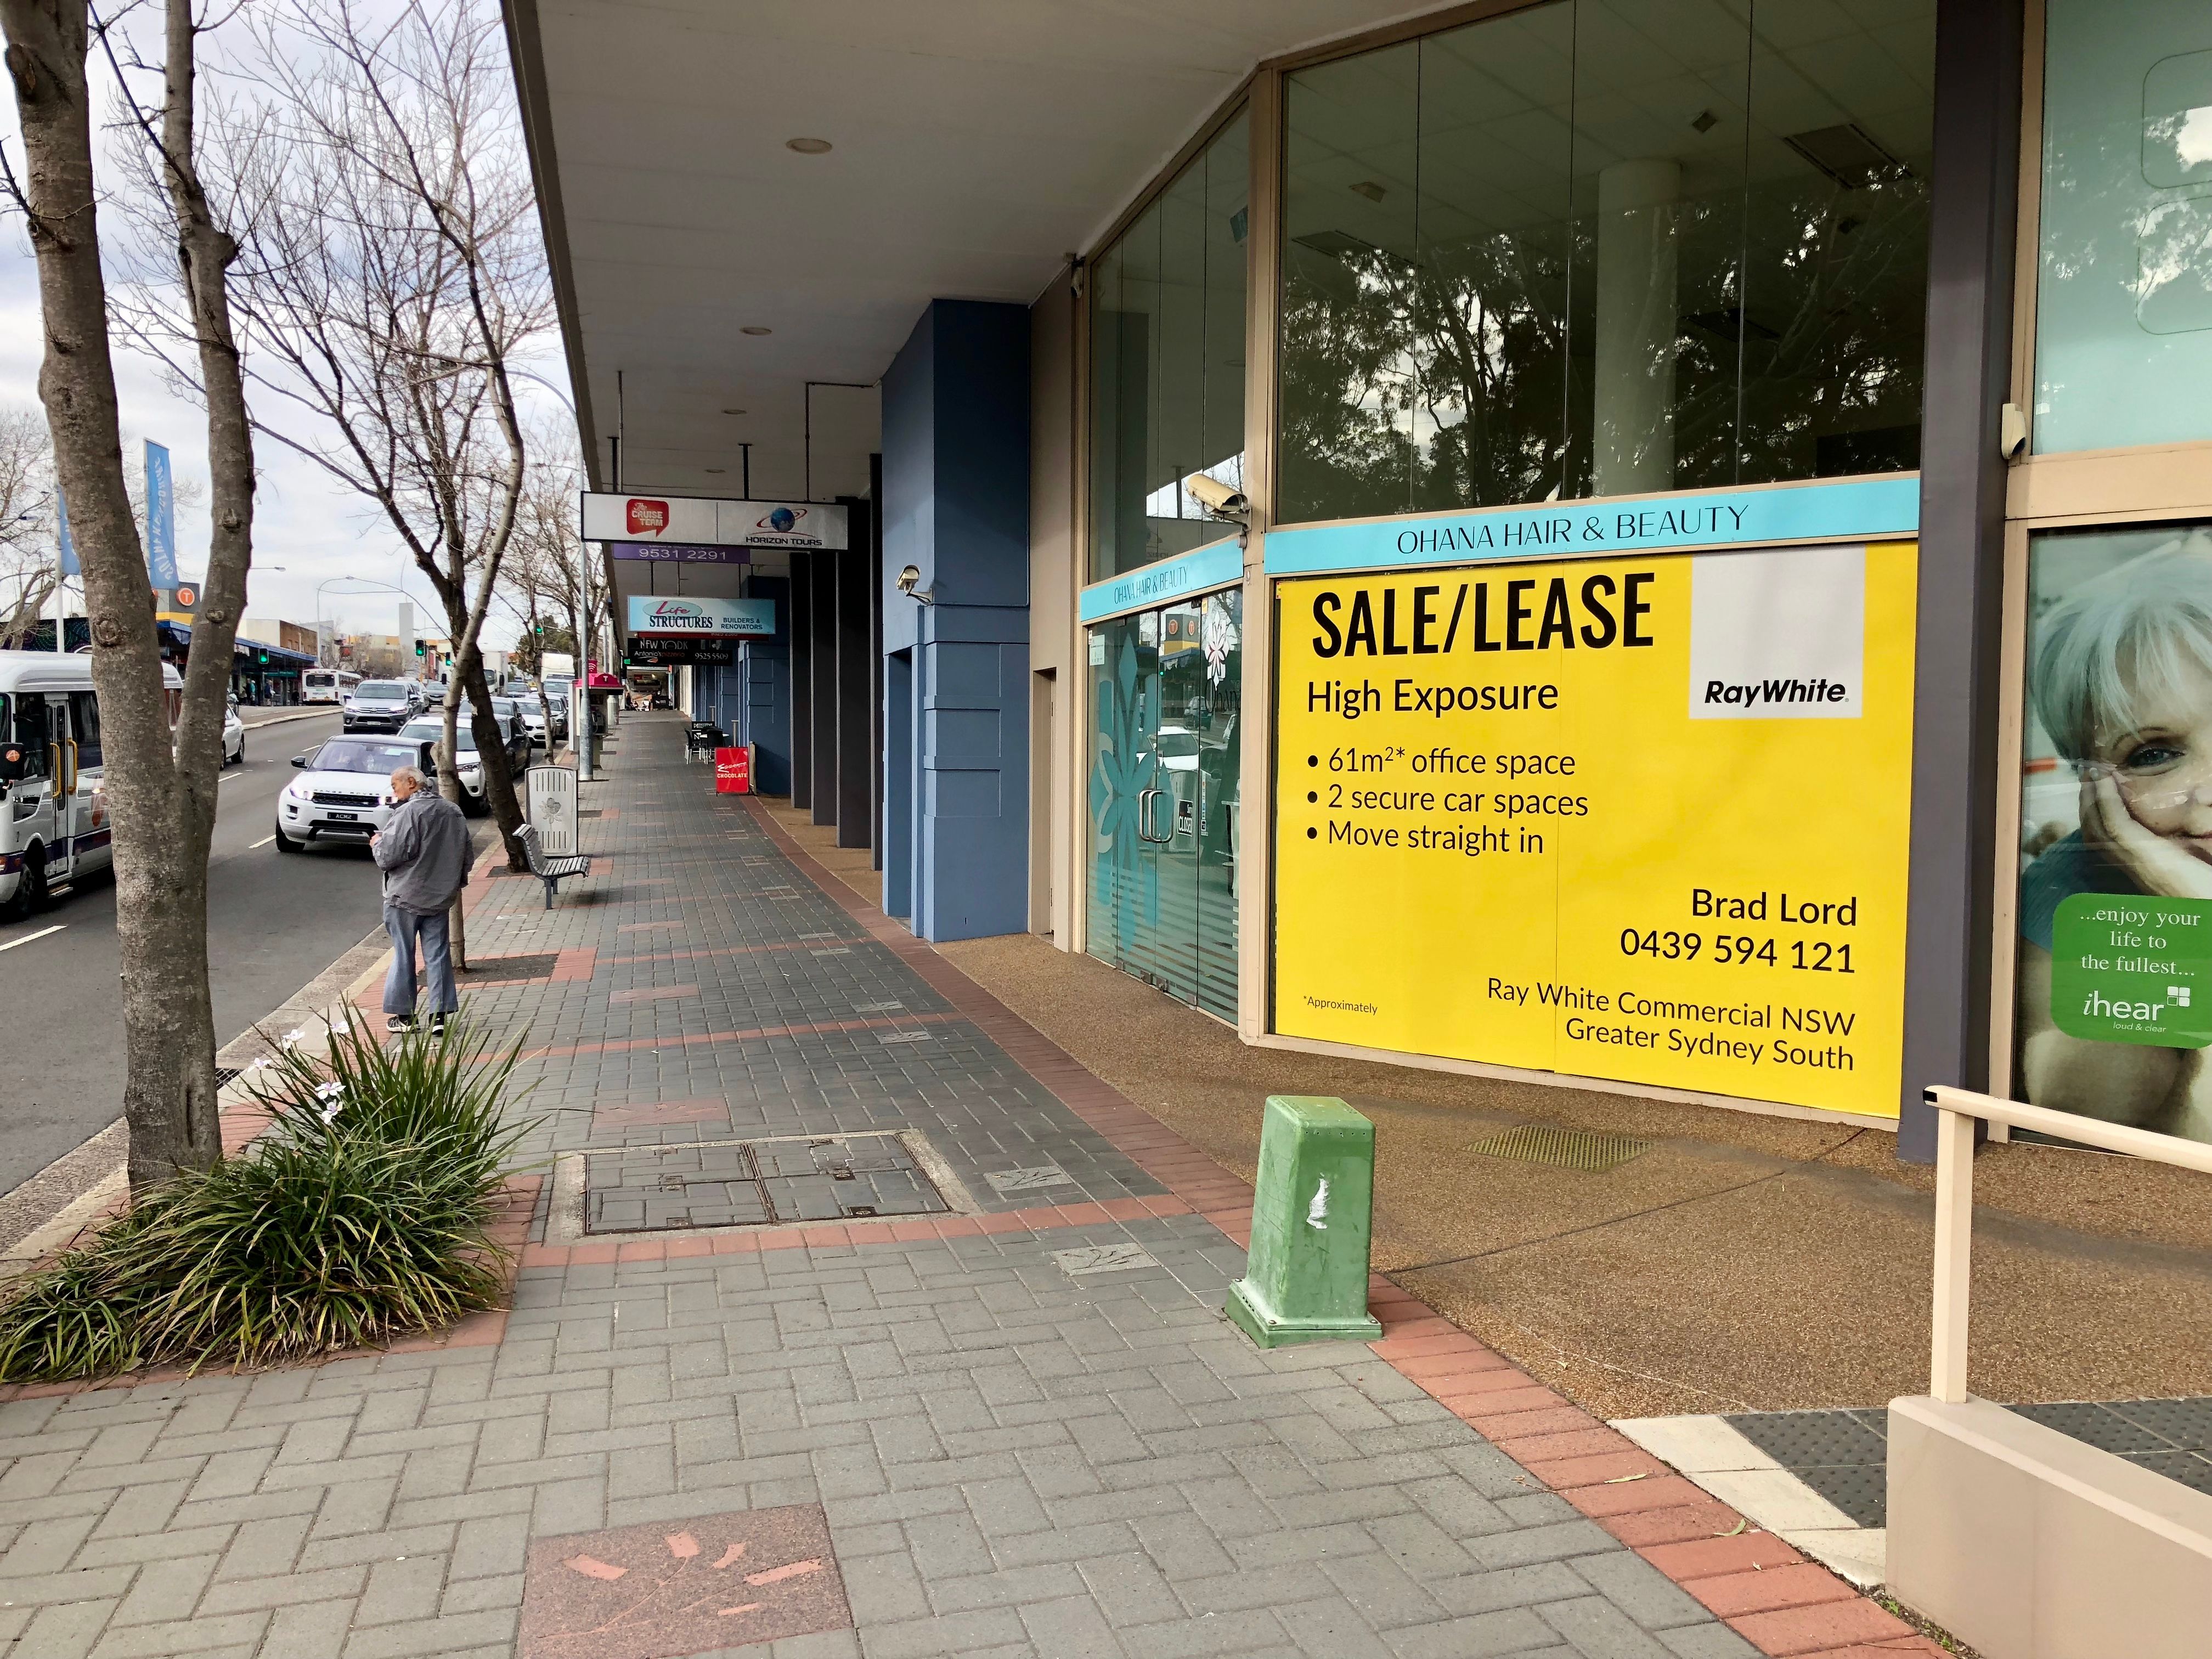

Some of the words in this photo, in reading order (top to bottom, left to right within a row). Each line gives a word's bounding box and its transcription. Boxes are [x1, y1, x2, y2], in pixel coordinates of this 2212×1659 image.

[631, 510, 663, 519] CRUISE
[1397, 525, 1494, 554] OHANA
[1504, 519, 1571, 547] HAIR
[1583, 516, 1605, 541] &
[1617, 504, 1748, 539] BEAUTY
[639, 549, 679, 558] 9531
[687, 551, 727, 560] 2291
[1114, 583, 1135, 605] OHANA
[1136, 578, 1150, 598] HAIR
[1153, 575, 1158, 593] &
[1160, 565, 1188, 591] BEAUTY
[650, 616, 713, 629] STRUCTURES
[656, 601, 691, 615] Life
[1312, 572, 1655, 659] SALE/LEASE
[1308, 680, 1381, 720] High
[1395, 679, 1559, 718] Exposure
[1412, 748, 1486, 773] office
[1496, 755, 1576, 780] space
[1328, 783, 1342, 808] 2
[1351, 790, 1435, 811] secure
[1444, 792, 1486, 812] car
[1494, 794, 1589, 819] spaces
[1329, 820, 1399, 847] Move
[1408, 825, 1510, 857] straight
[1520, 827, 1543, 854] in
[1692, 888, 1767, 920] Brad
[1780, 893, 1857, 926] Lord
[2155, 913, 2202, 928] your
[1621, 928, 1701, 961] 0439
[1714, 935, 1778, 967] 594
[1791, 940, 1855, 973] 121
[2109, 930, 2141, 947] life
[2148, 935, 2167, 949] to
[2081, 954, 2109, 970] the
[1488, 978, 1530, 1006] Ray
[1536, 983, 1610, 1012] White
[1618, 992, 1771, 1029] Commercial
[1782, 1006, 1855, 1036] NSW
[2083, 990, 2165, 1021] ihear
[1566, 1018, 1660, 1048] Greater
[1668, 1029, 1764, 1065] Sydney
[1773, 1040, 1854, 1071] South
[2113, 1022, 2134, 1031] loud
[2145, 1024, 2166, 1033] clear
